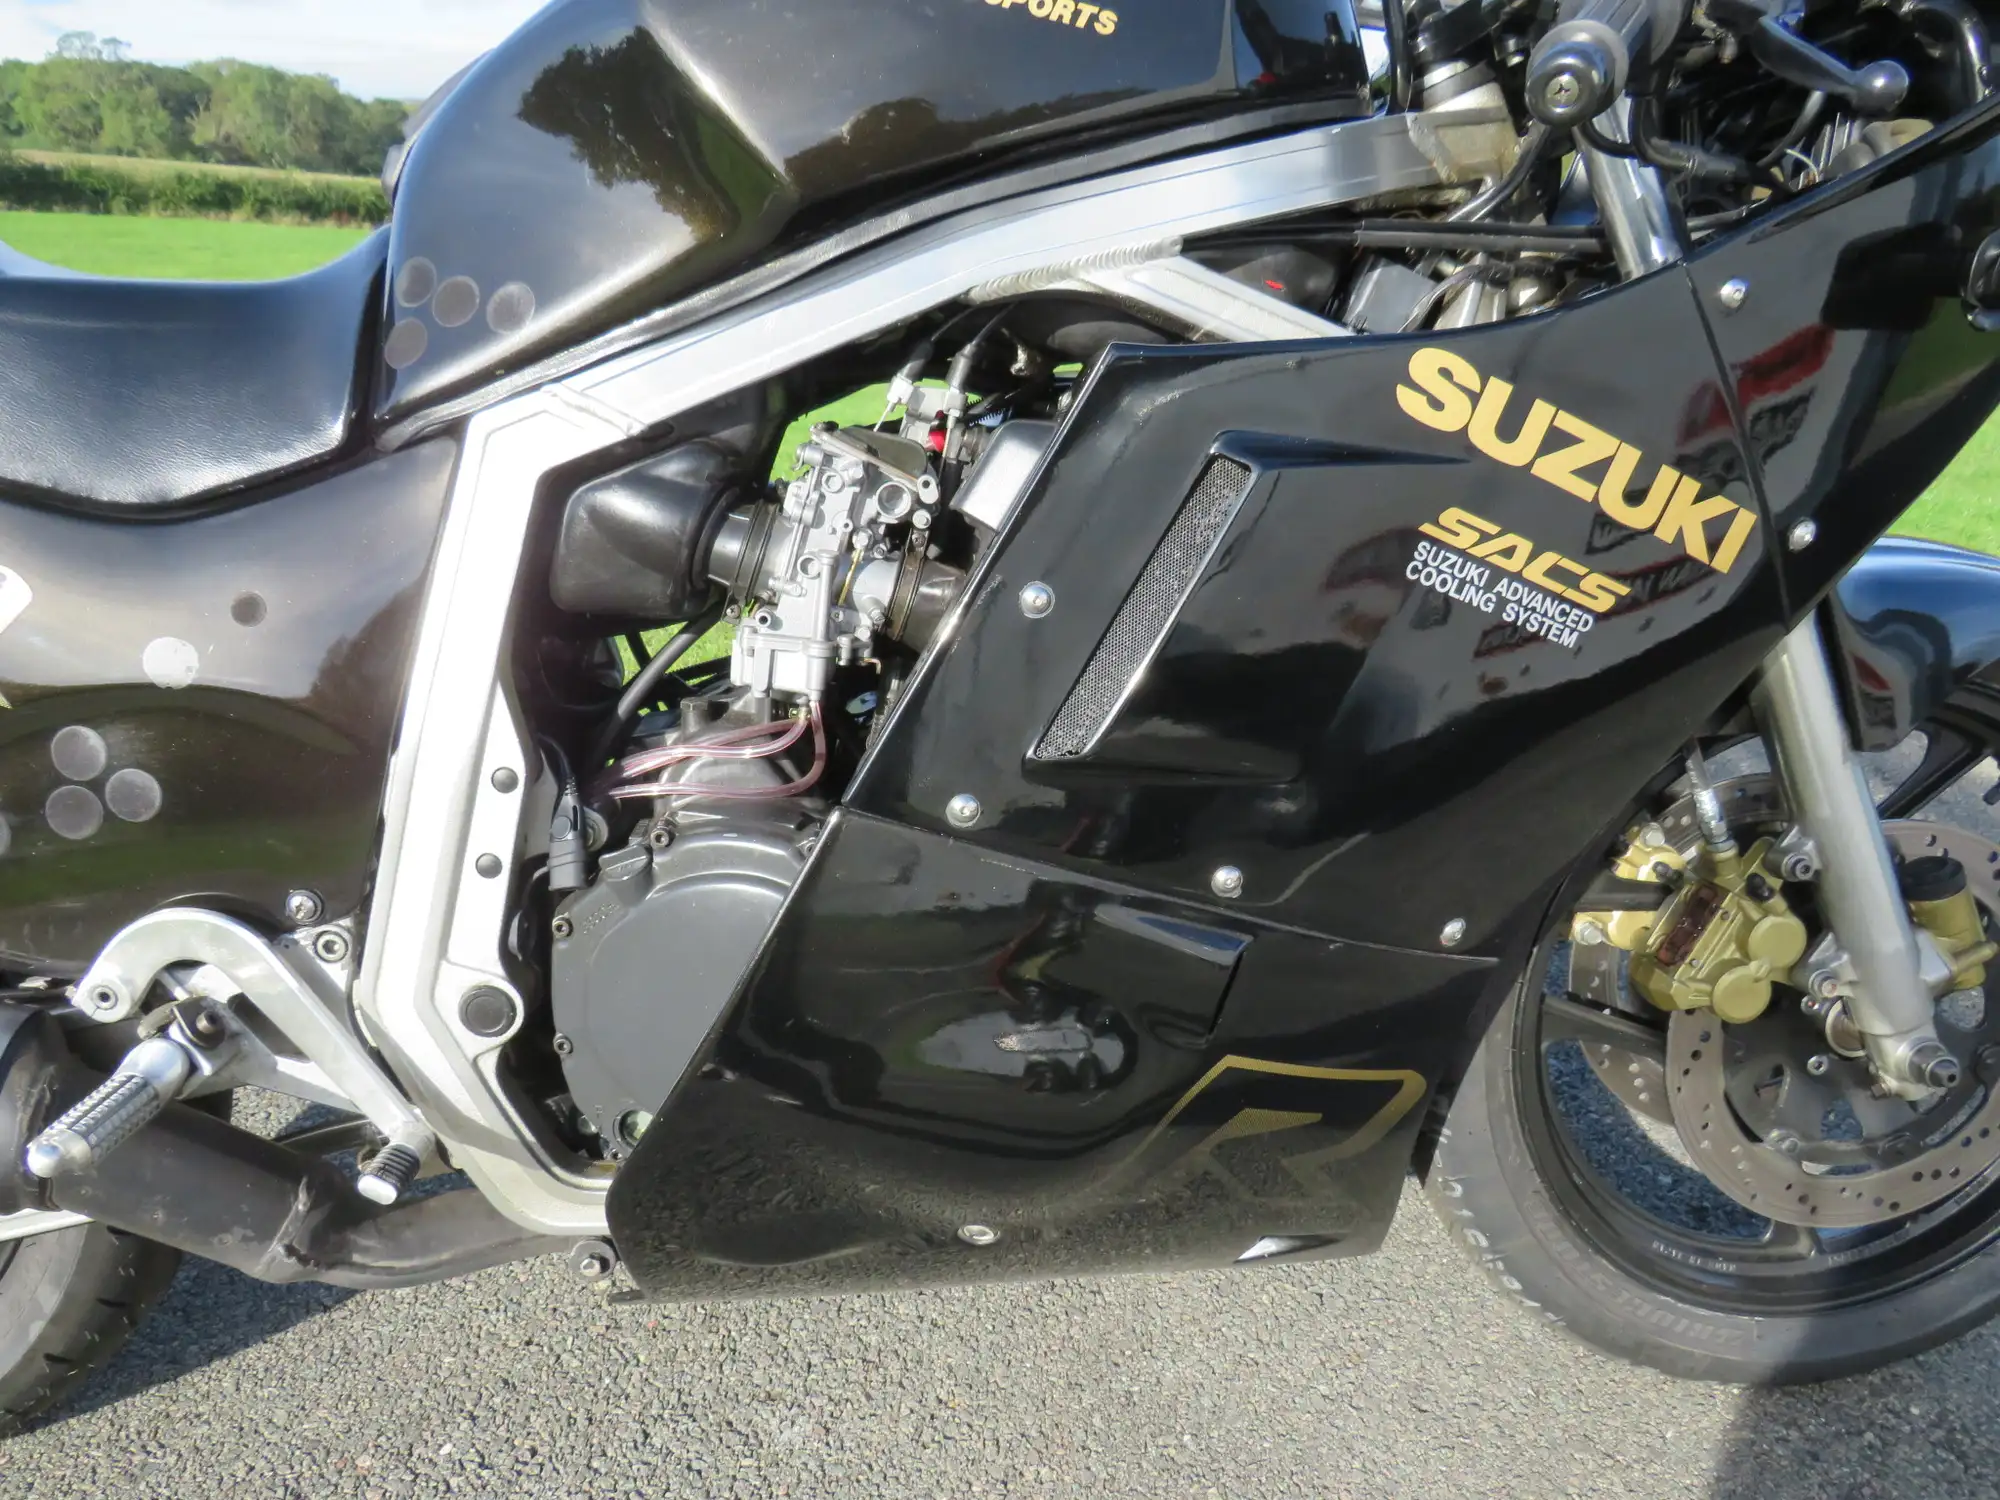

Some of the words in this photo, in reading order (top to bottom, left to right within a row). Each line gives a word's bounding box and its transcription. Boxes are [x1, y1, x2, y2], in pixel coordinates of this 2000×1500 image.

[984, 0, 1118, 35] ORTS
[1396, 347, 1758, 574] SUZUKI
[1405, 560, 1496, 613] COOLING
[1502, 603, 1580, 648] SYSTEM
[1413, 541, 1491, 587] SUZUKI
[1493, 577, 1594, 633] ADVANCED
[1418, 506, 1633, 613] SACS
